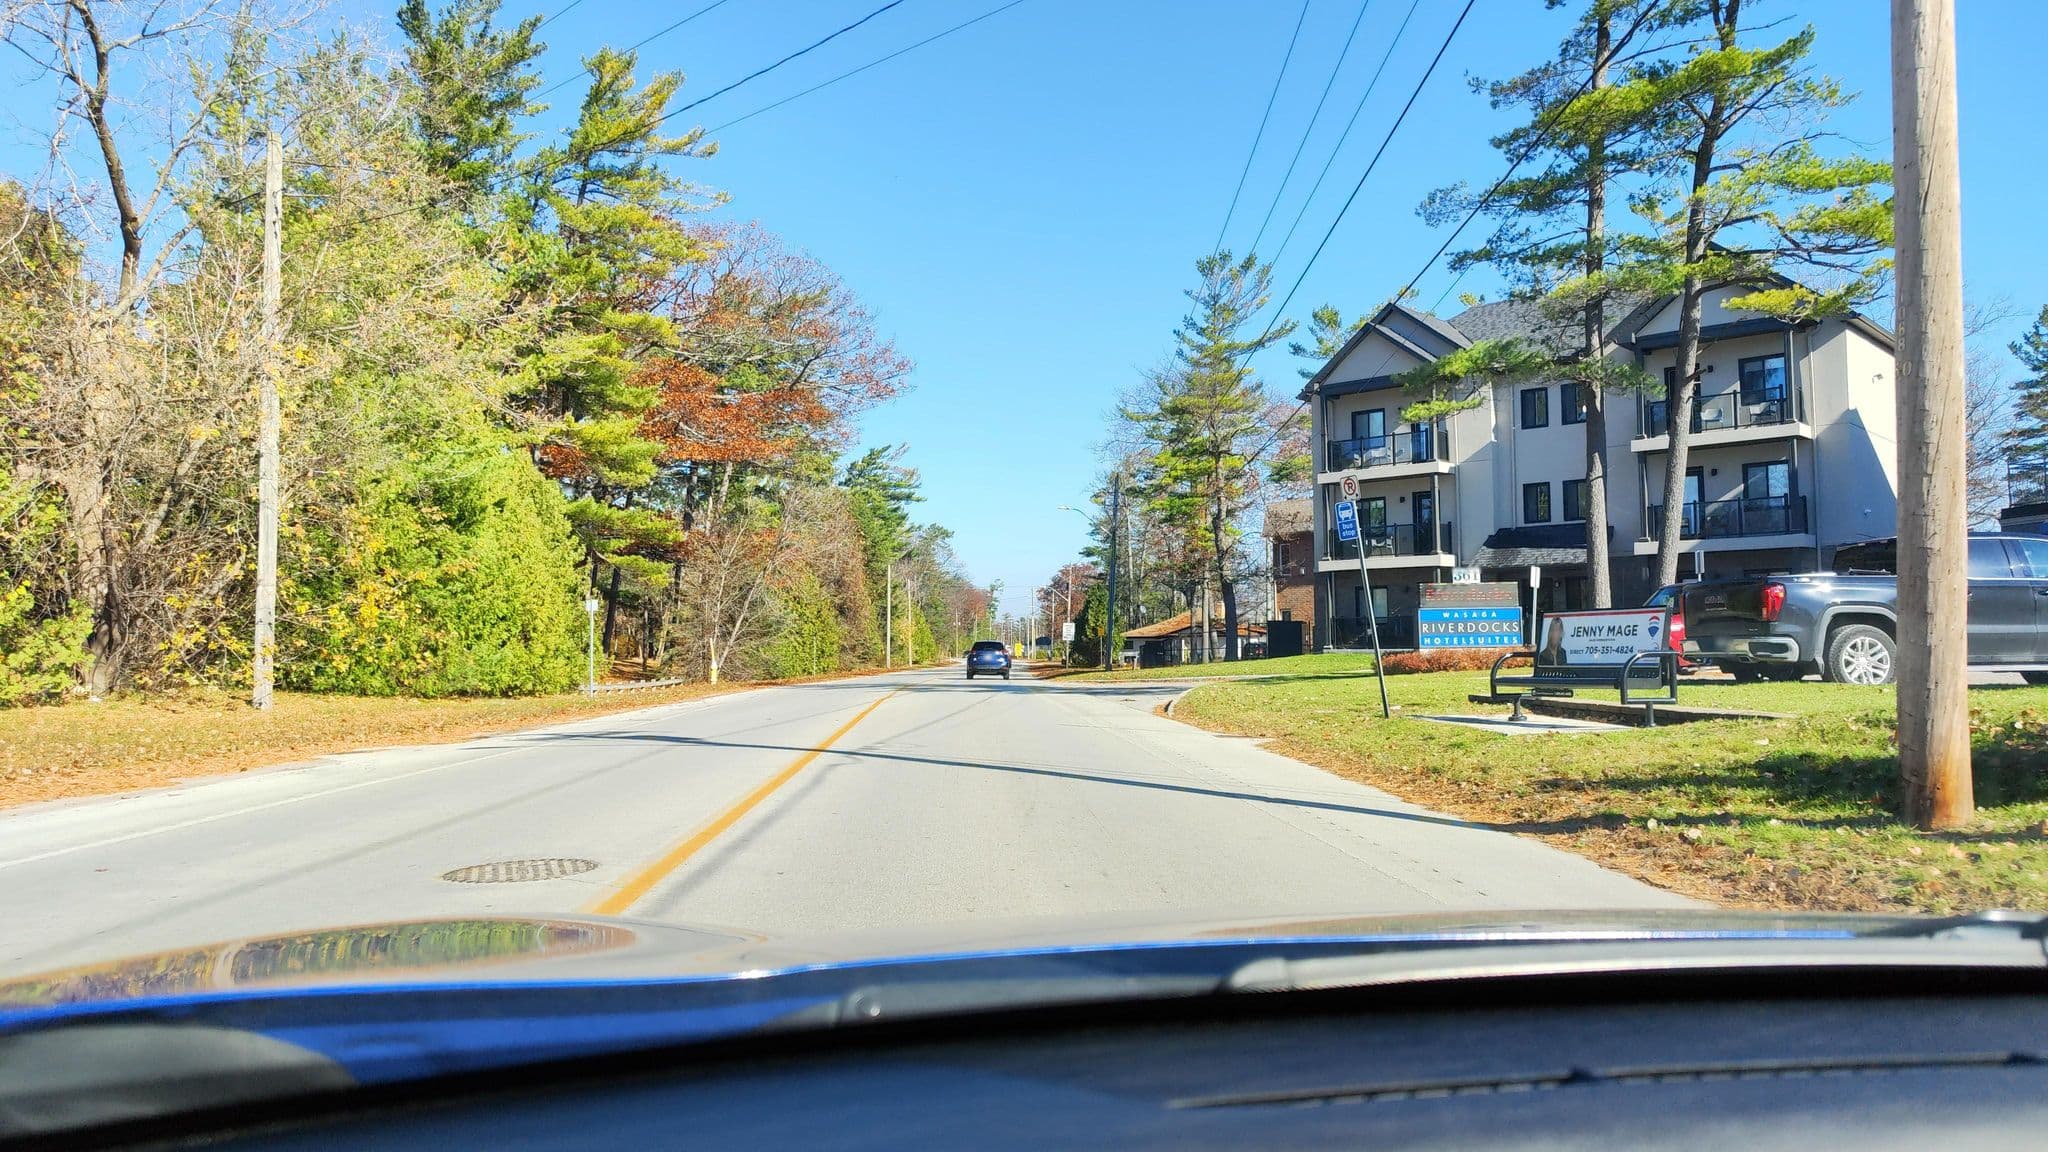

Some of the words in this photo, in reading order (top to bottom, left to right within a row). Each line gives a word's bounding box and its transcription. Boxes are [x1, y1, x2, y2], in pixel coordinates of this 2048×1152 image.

[1422, 622, 1519, 633] RIVERDOCKS
[1570, 625, 1605, 638] JENNY
[1606, 624, 1639, 637] MAGE
[1585, 645, 1634, 655] 705-351-4824
